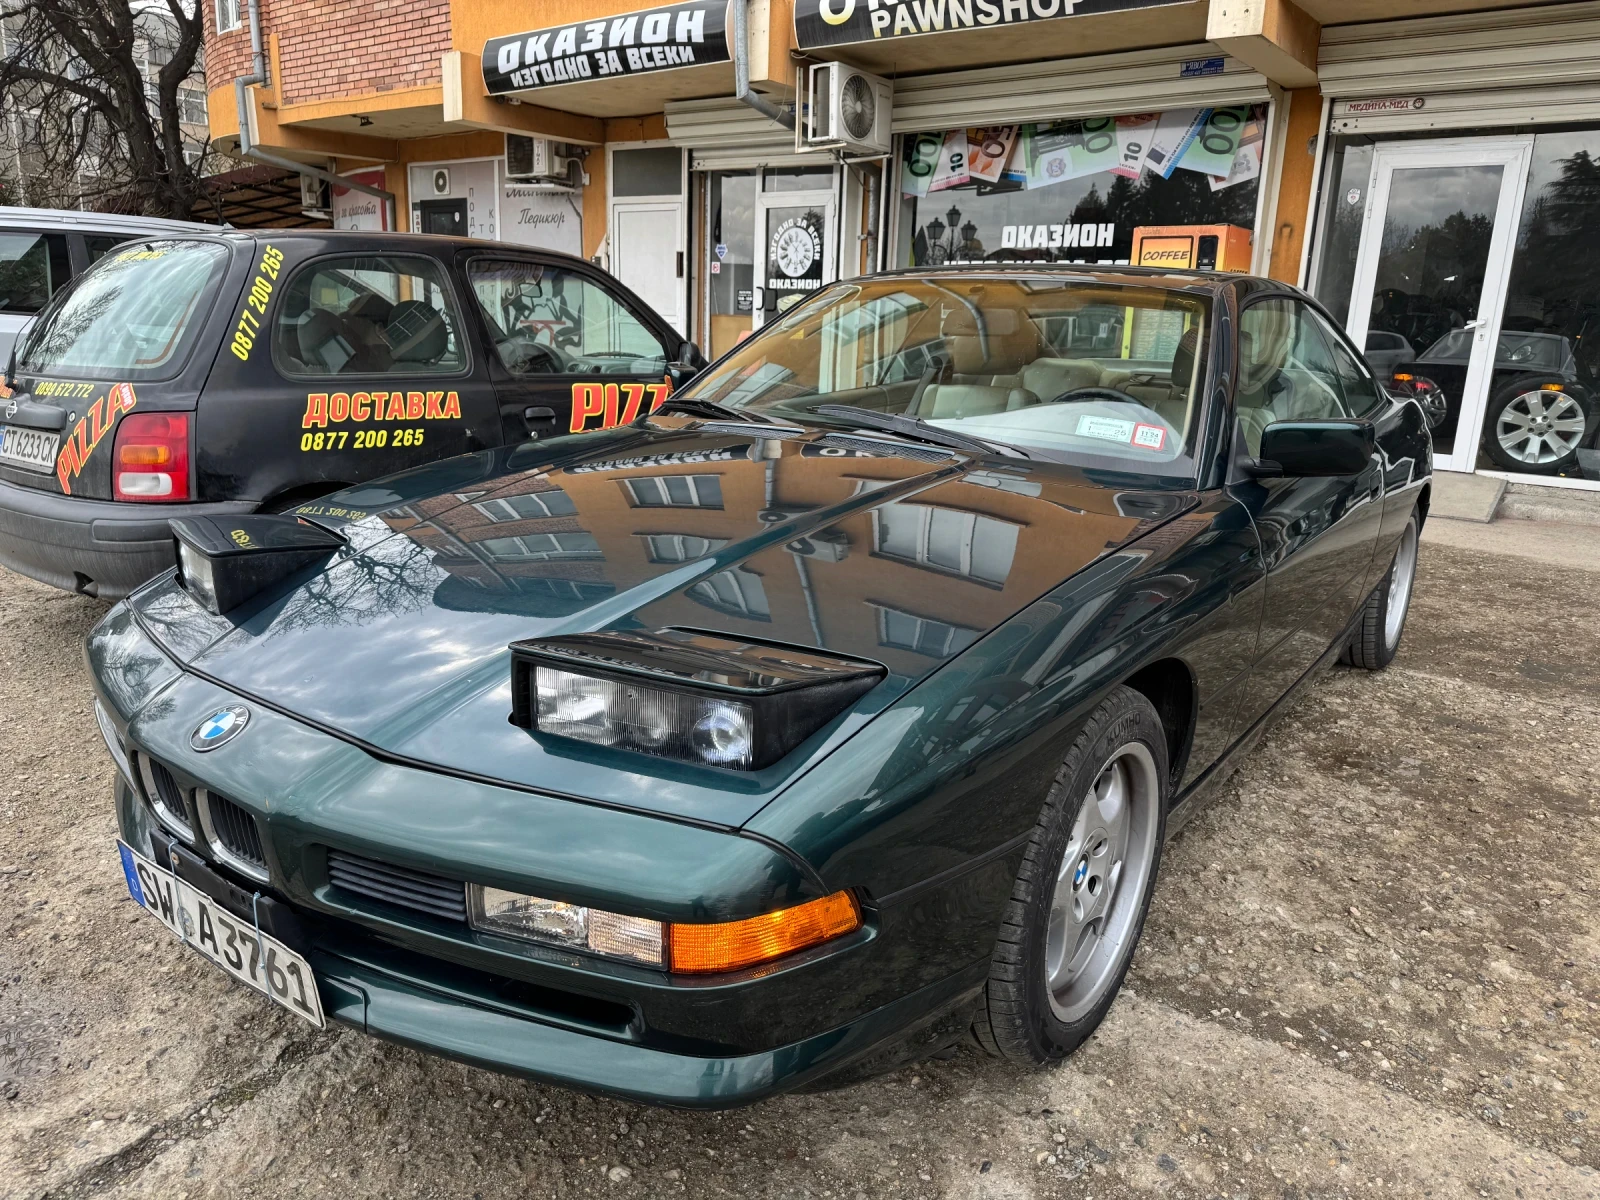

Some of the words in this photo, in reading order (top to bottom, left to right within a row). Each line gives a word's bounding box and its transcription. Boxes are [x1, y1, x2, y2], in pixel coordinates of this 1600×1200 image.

[870, 0, 1084, 38] PAWNSHOP
[498, 10, 706, 74] ОКАЗИОН
[510, 54, 592, 88] ИЗГОДНО
[594, 50, 623, 75] ЗА
[626, 46, 695, 71] ВСЕКИ
[950, 152, 963, 172] 10
[1124, 142, 1142, 162] 10
[518, 208, 565, 228] Педикюр
[770, 218, 794, 261] ИЗГОДНО
[796, 217, 807, 229] ЗА
[808, 225, 821, 261] ВСЕКИ
[1001, 223, 1115, 248] ОКАЗИОН
[260, 245, 284, 280] 265
[1143, 250, 1189, 261] COFFEE
[248, 276, 273, 314] 200
[769, 279, 821, 290] ОКАЗИОН
[231, 309, 259, 361] 0877
[55, 383, 75, 397] 672
[72, 384, 94, 398] 772
[302, 391, 461, 428] ДОСТАВКА
[16, 434, 41, 460] 6233
[57, 382, 136, 495] PIZZA
[300, 431, 348, 451] 0877
[353, 430, 387, 448] 200
[392, 429, 424, 446] 265
[1106, 712, 1141, 746] KUMHO
[137, 861, 175, 926] SW
